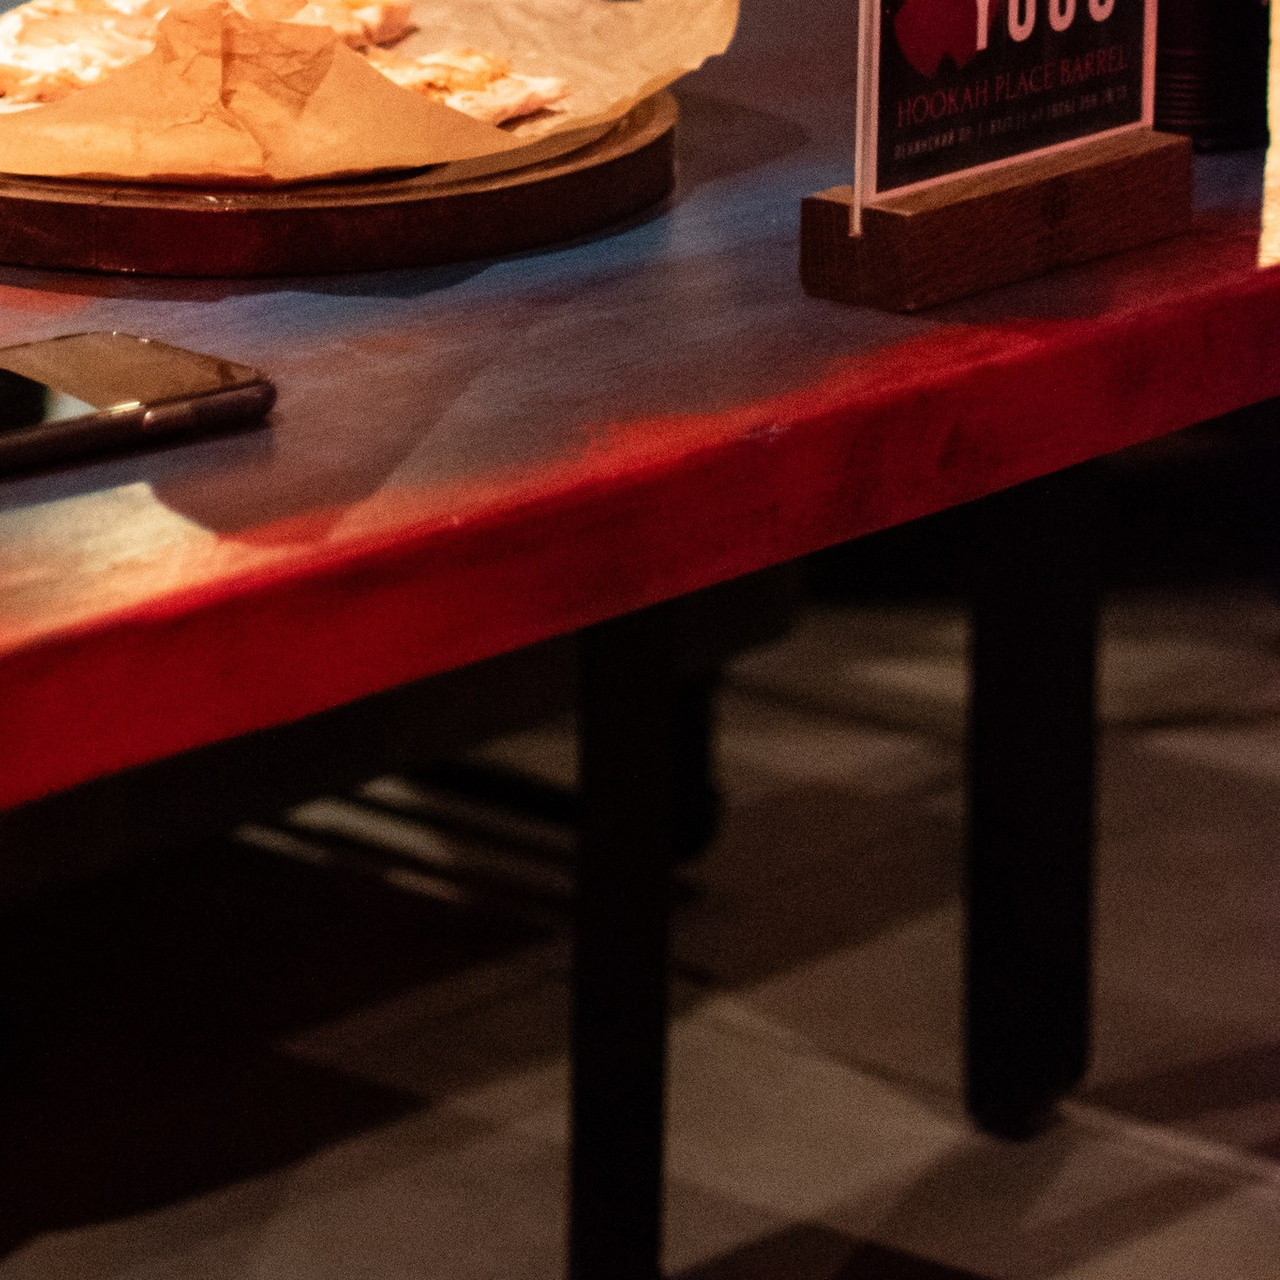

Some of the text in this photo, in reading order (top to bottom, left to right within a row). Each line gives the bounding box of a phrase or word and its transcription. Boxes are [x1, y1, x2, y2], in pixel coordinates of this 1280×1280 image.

[897, 78, 989, 128] HOOKAH
[995, 62, 1055, 103] PLACE
[1059, 45, 1128, 87] BARREL
